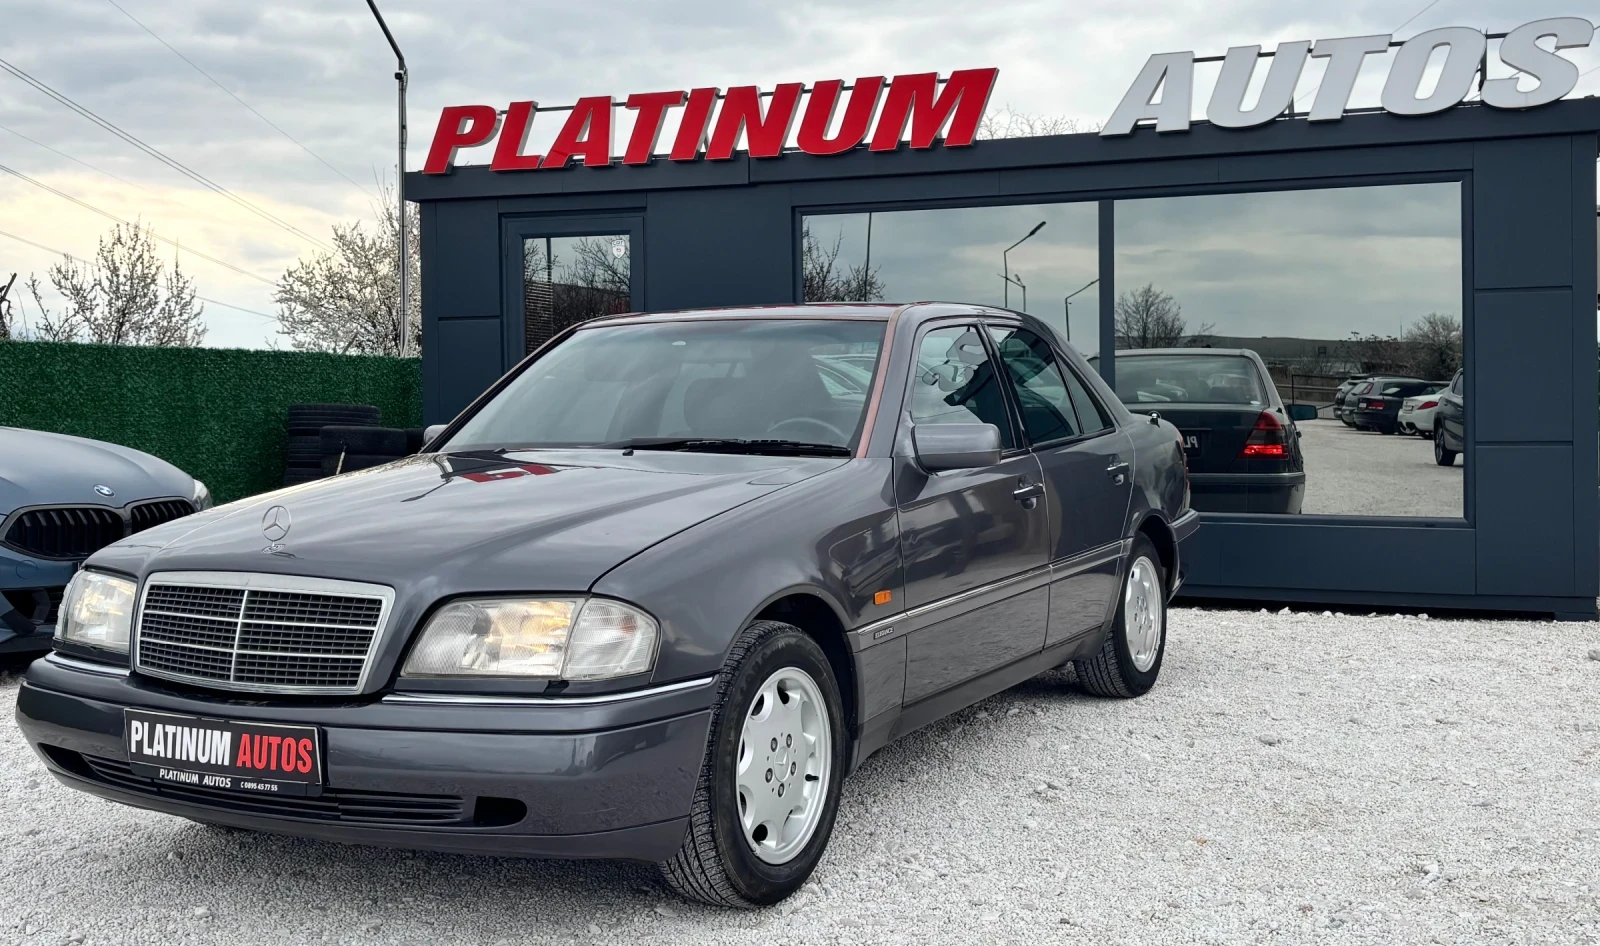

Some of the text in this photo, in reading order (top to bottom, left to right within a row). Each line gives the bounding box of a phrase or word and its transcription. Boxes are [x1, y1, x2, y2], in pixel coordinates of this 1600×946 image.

[421, 17, 1596, 174] PLATINUM AUTOS
[130, 720, 313, 774] PLATINUM AUTOS
[159, 768, 199, 784] PLATINUM
[202, 775, 232, 788] AUTOS
[244, 781, 257, 790] 0895
[264, 783, 271, 791] 77
[271, 784, 278, 792] 55
